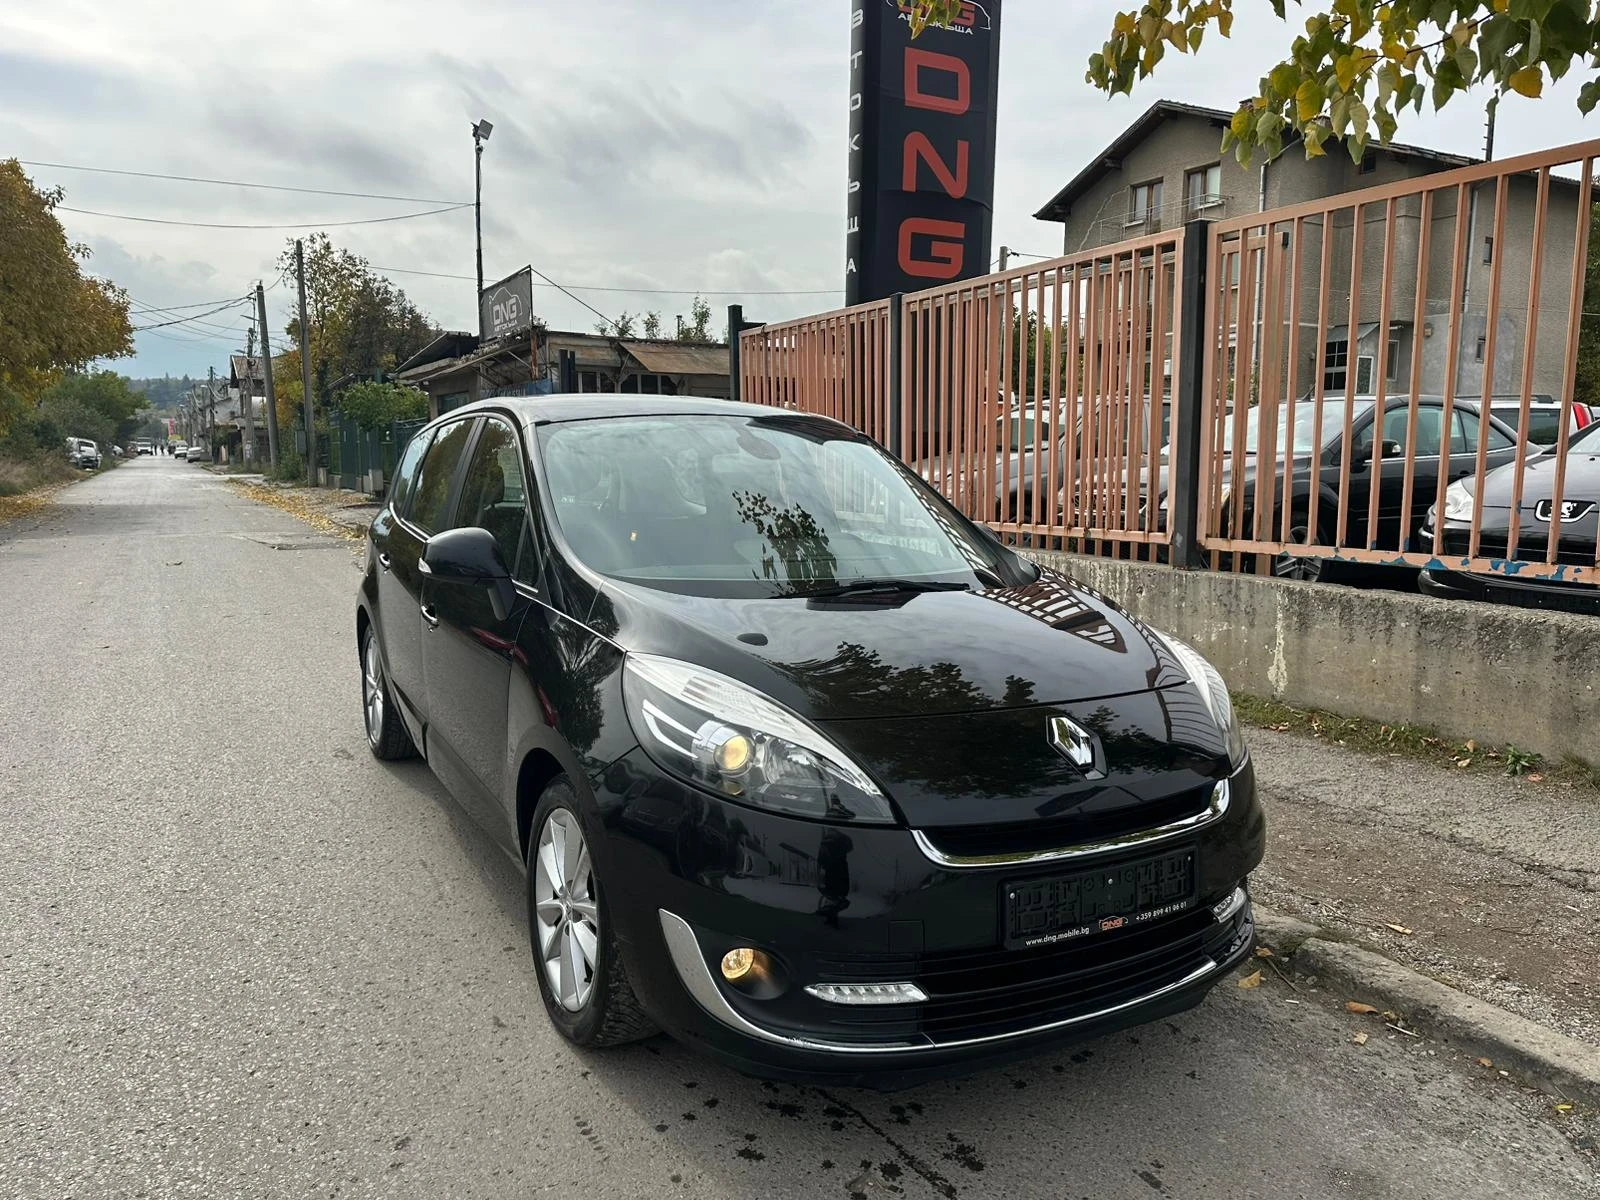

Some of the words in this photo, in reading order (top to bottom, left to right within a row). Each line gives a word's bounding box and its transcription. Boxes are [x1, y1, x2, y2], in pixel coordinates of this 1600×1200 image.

[898, 46, 970, 279] DNG
[493, 297, 517, 326] DNG
[1025, 926, 1090, 946] www.dng.mobile.bg
[1136, 911, 1152, 921] +359
